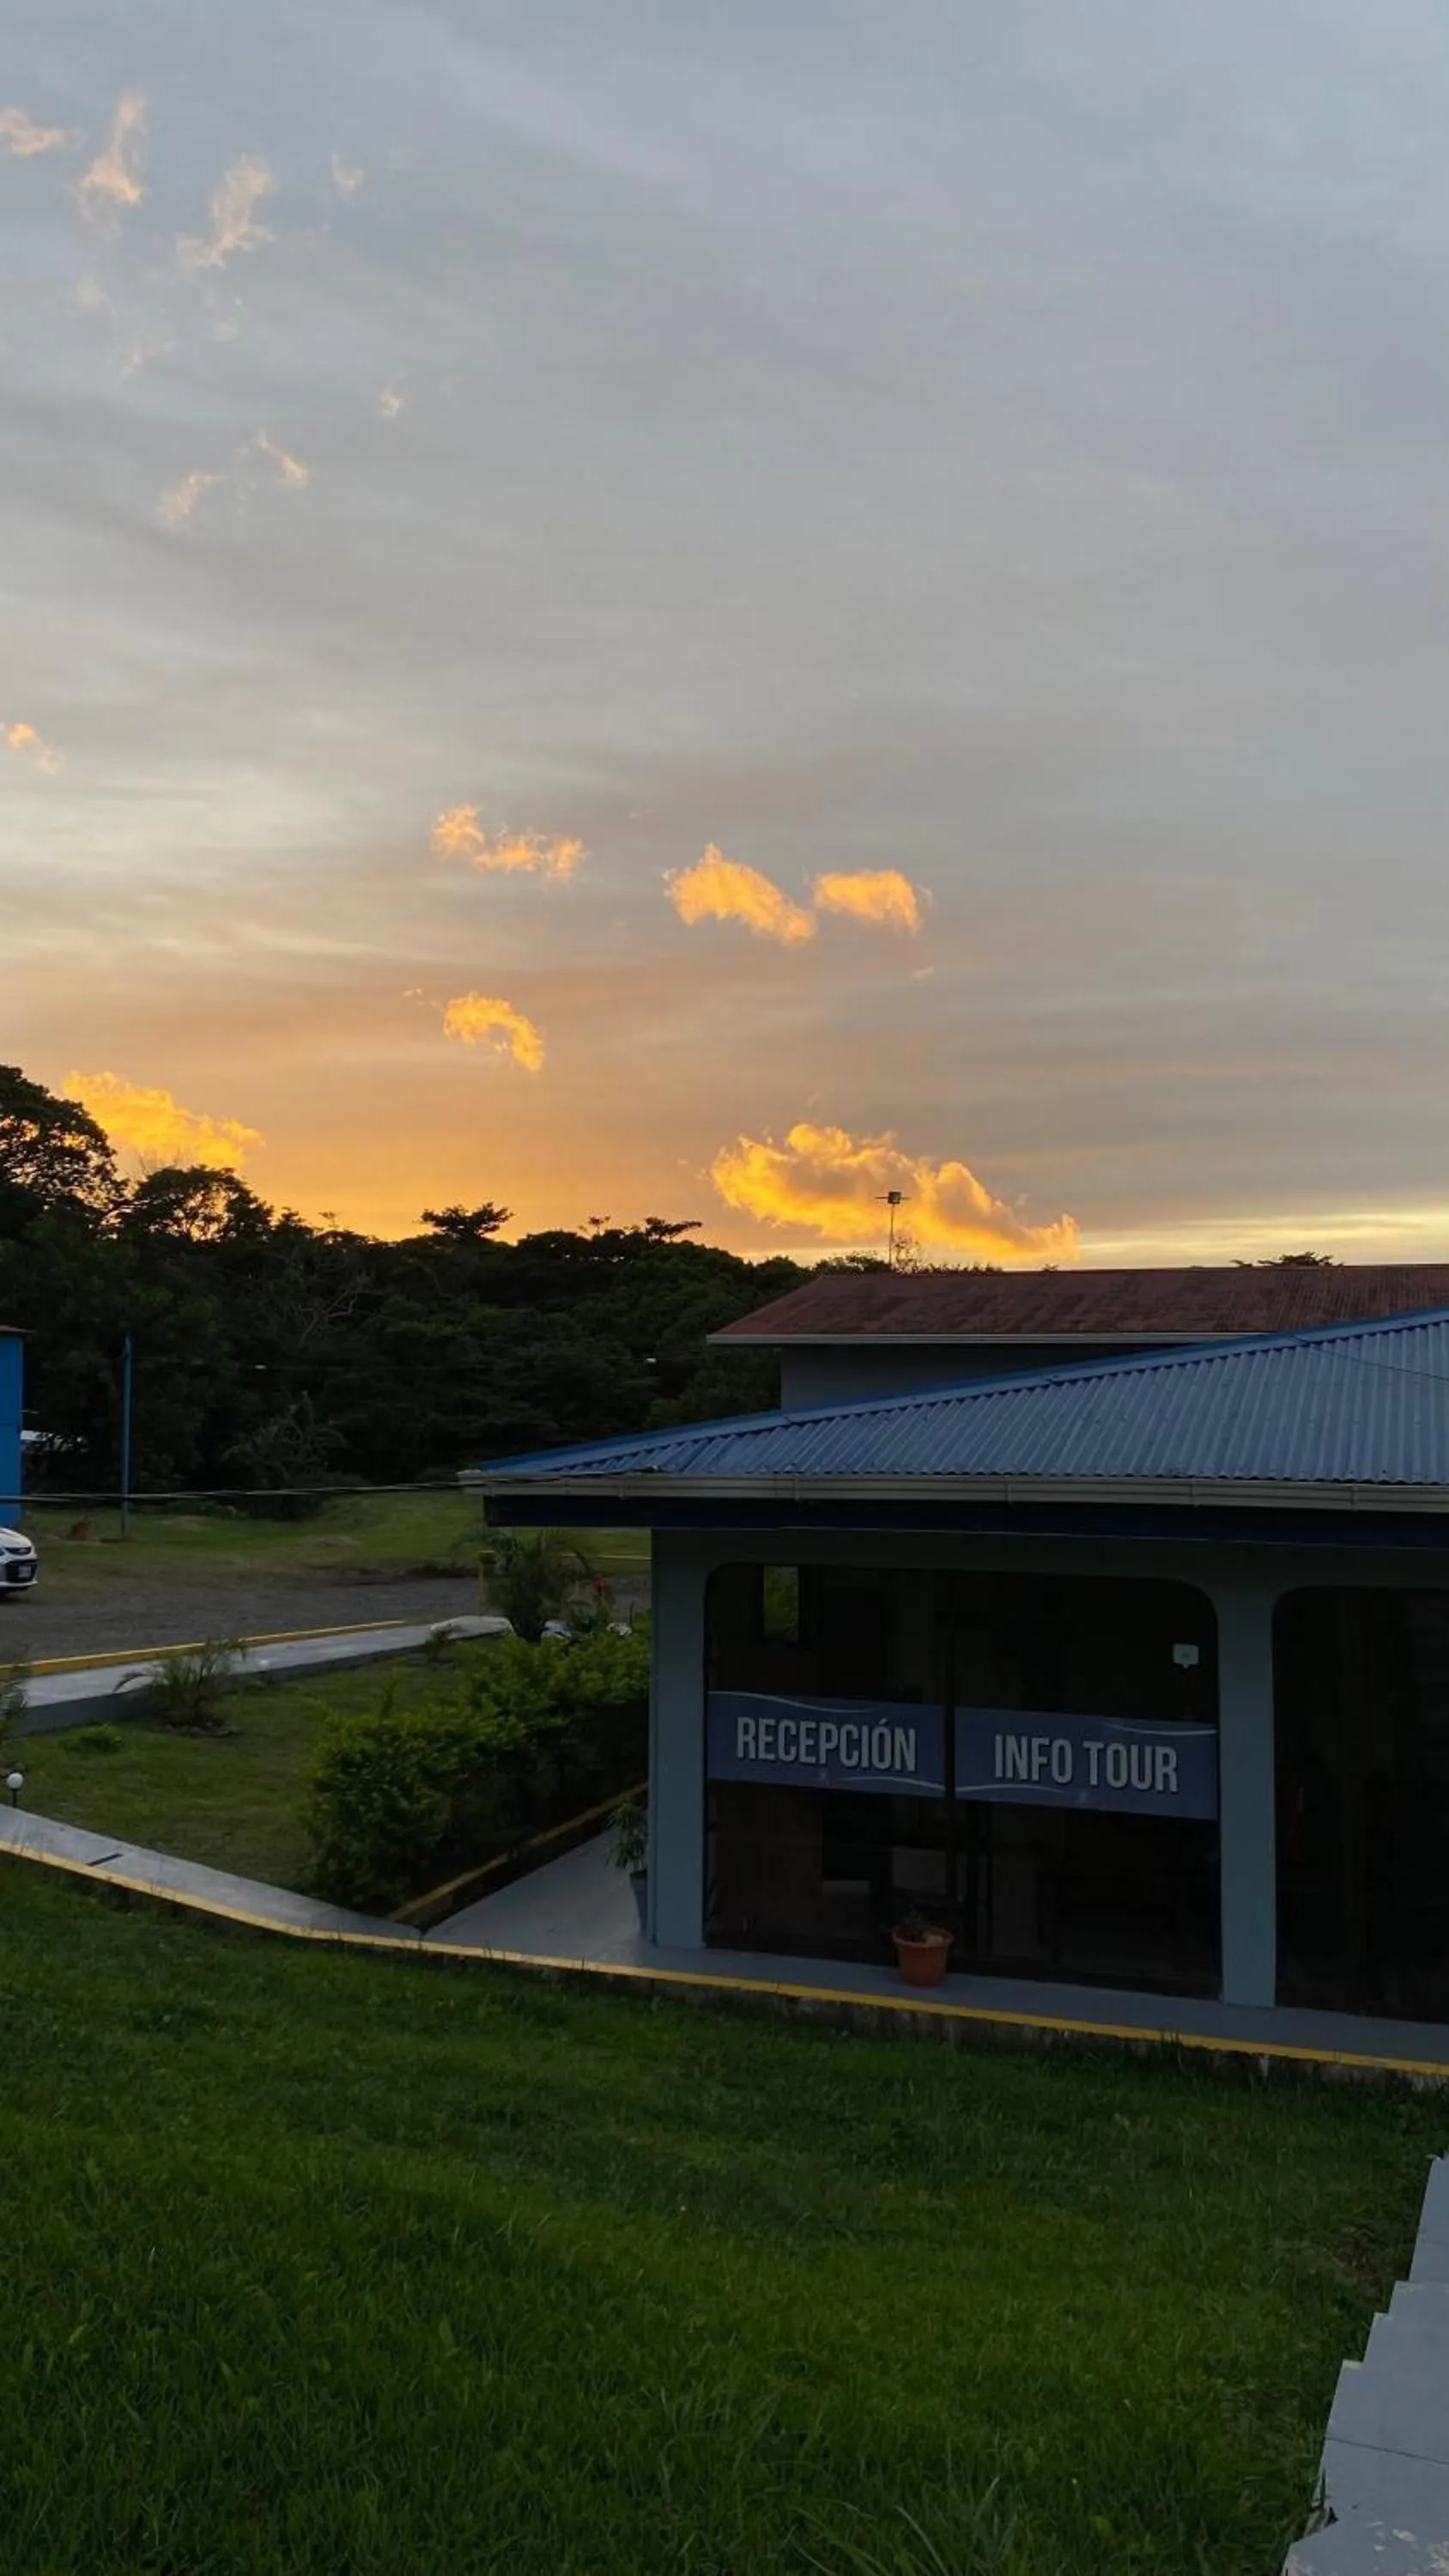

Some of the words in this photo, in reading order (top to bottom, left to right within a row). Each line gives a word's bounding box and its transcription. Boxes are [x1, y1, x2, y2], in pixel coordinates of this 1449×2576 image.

[737, 1716, 917, 1772] RECEPCIÓN
[994, 1734, 1072, 1784] INFO
[1082, 1741, 1179, 1793] TOUR
